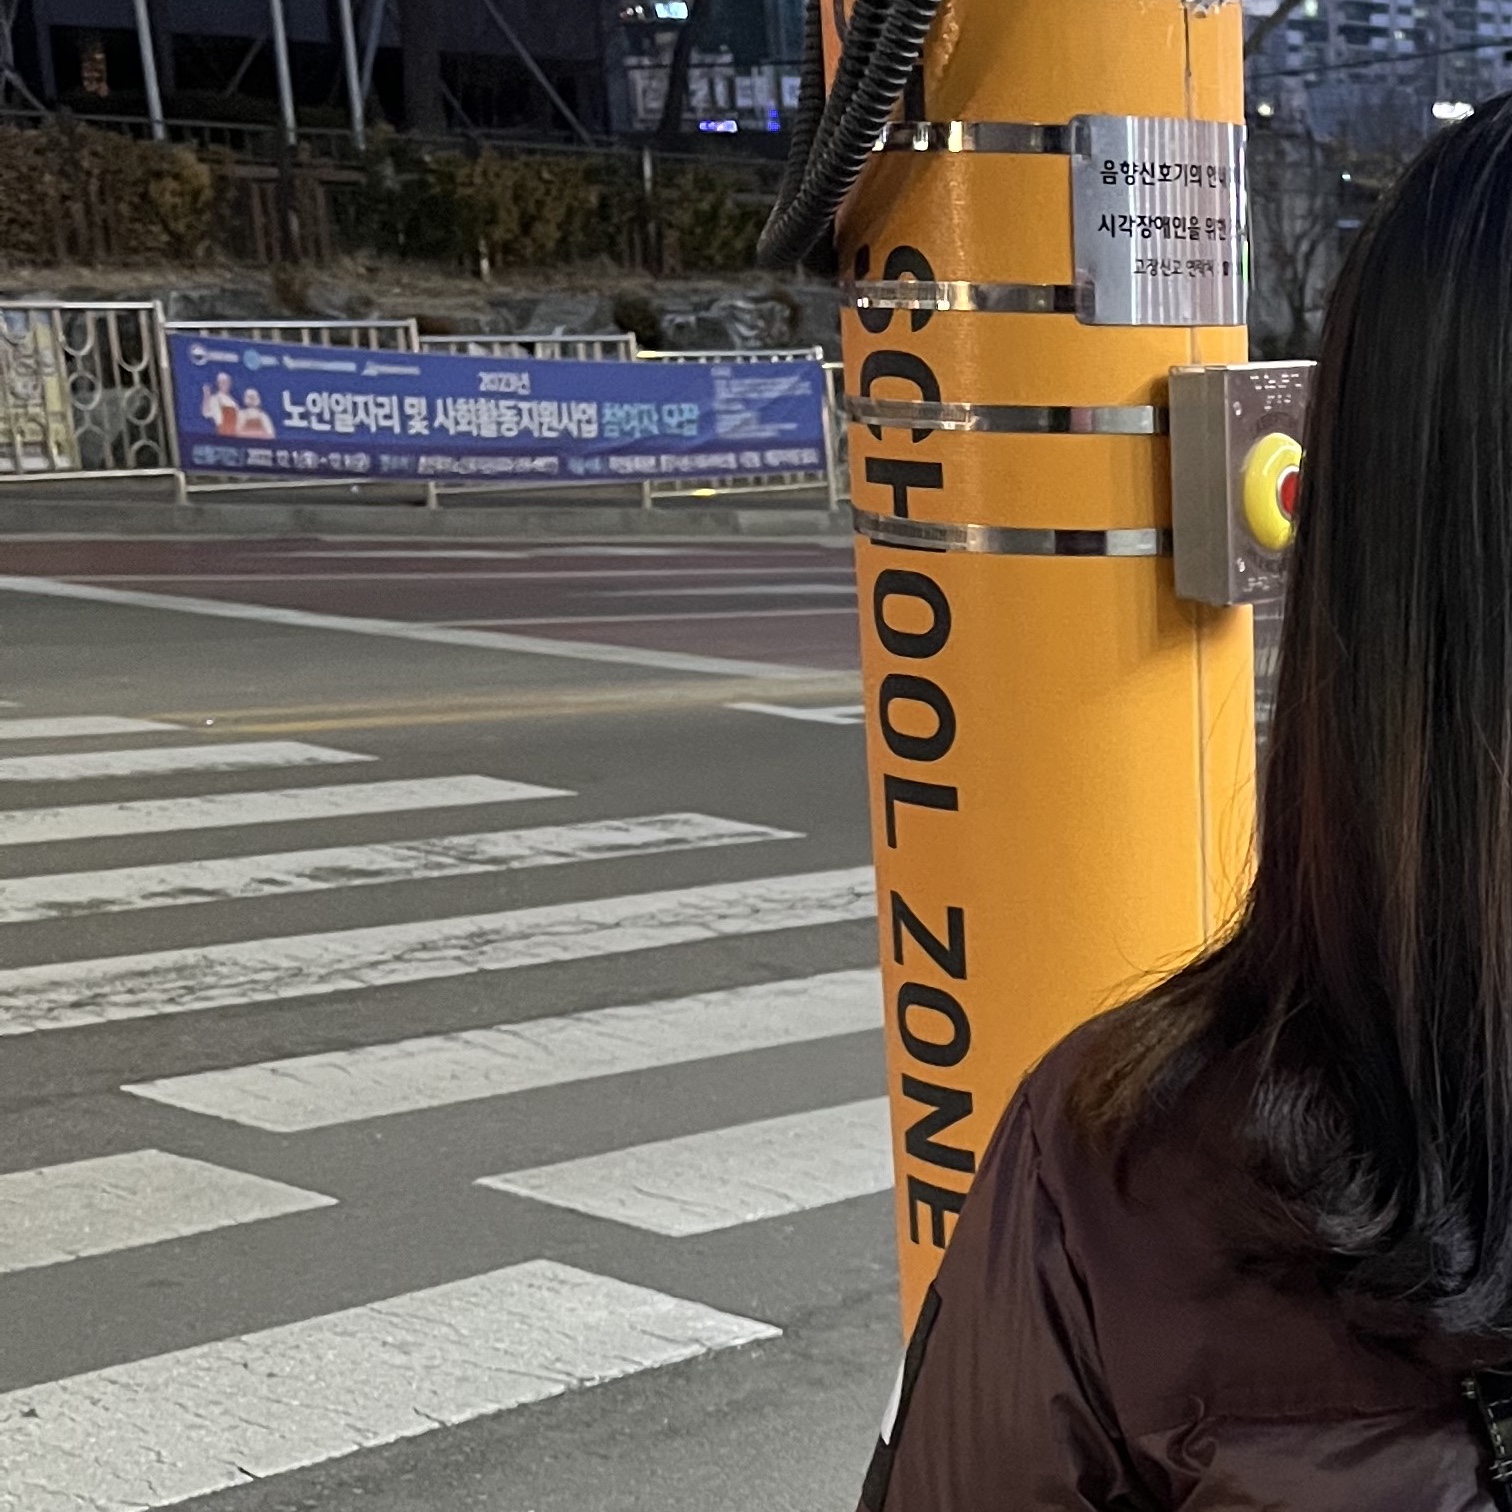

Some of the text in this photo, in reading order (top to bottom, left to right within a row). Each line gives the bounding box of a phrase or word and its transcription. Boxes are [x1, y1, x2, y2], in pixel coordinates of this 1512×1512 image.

[1100, 160, 1203, 188] 음향신호기의
[1098, 213, 1201, 241] 시각장애인을
[1133, 258, 1183, 277] 고장신고
[282, 389, 401, 435] 노인일자리
[404, 396, 430, 435] 및
[433, 397, 599, 439] 사회활동지원사업
[854, 244, 960, 849] SCHOOL
[890, 890, 977, 1250] ZONE
